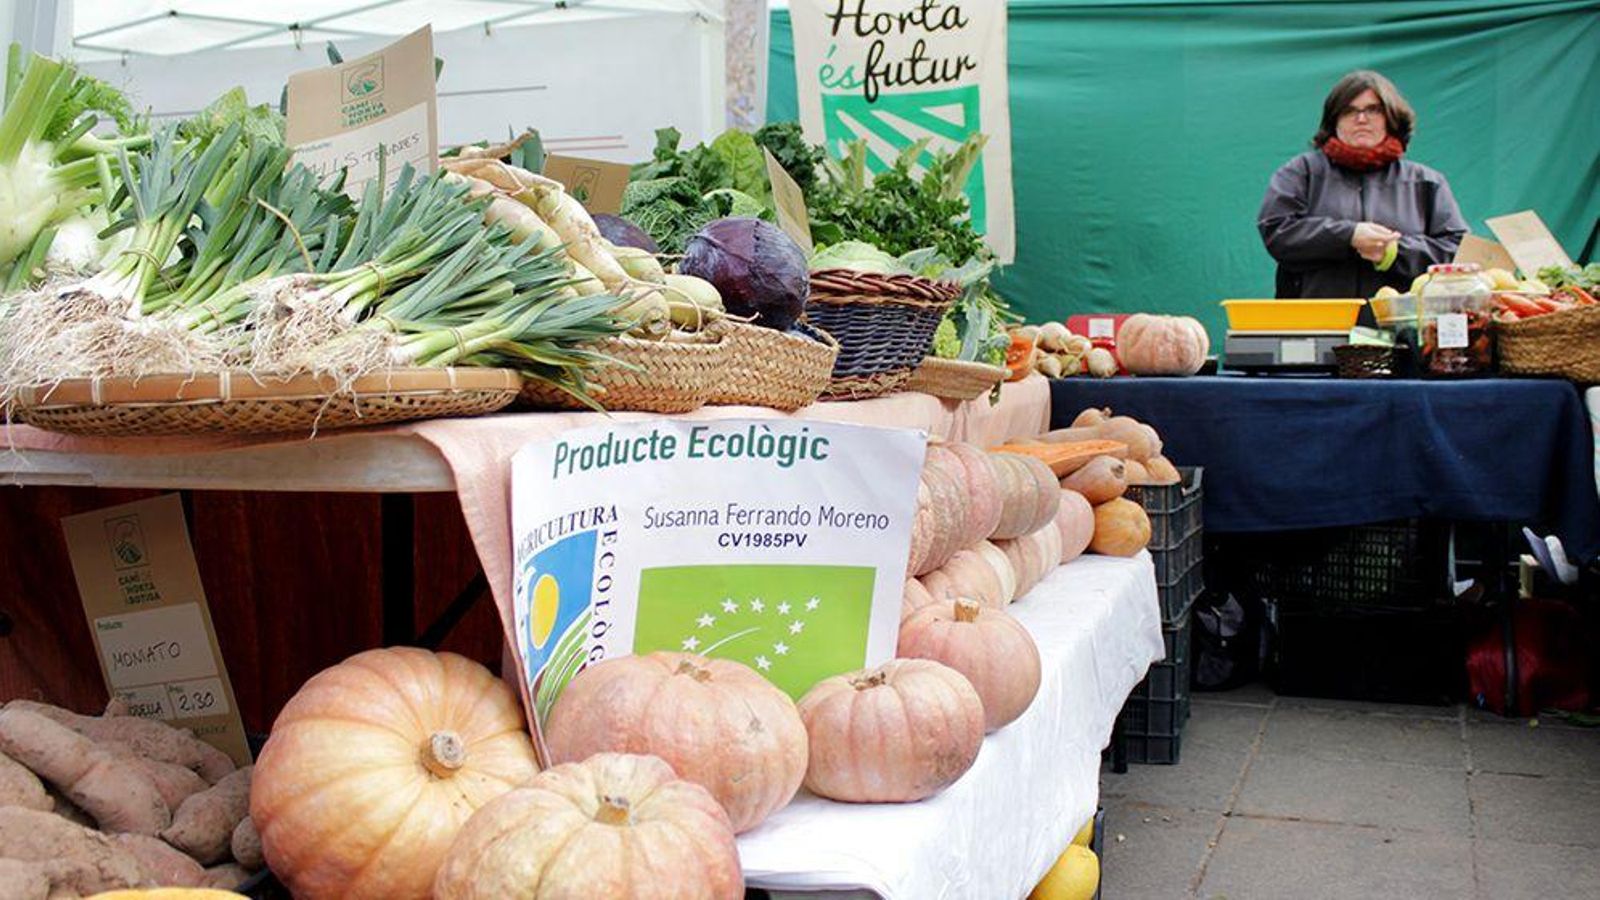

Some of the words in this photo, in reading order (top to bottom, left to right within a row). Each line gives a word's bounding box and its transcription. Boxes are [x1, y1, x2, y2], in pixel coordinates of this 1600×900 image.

[825, 0, 969, 37] Horta
[864, 39, 977, 104] futur
[552, 428, 677, 480] Producte
[687, 425, 830, 469] Ecològic
[643, 505, 719, 530] Susanna
[725, 503, 812, 528] Ferrando
[817, 504, 890, 530] Moreno
[717, 532, 808, 548] CV1985PV
